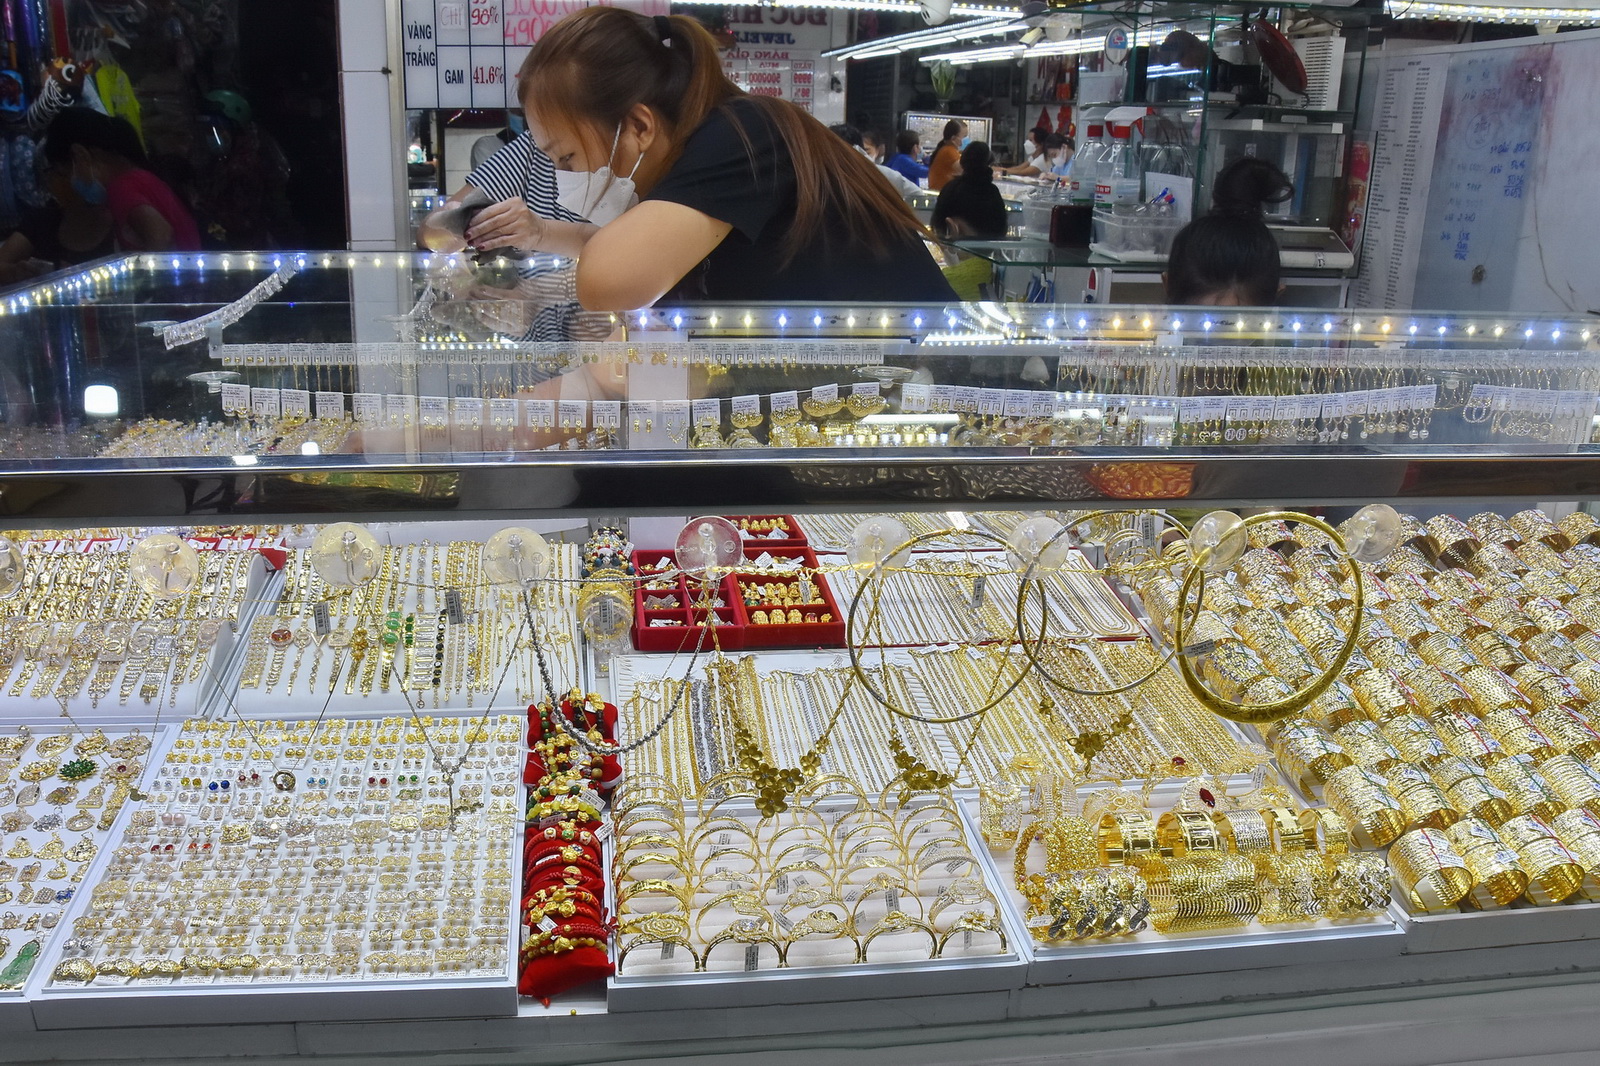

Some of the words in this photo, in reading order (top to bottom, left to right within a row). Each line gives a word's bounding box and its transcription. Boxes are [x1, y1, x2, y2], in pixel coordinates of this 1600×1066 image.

[471, 6, 499, 25] 98%
[407, 21, 432, 40] VÀNG
[405, 45, 436, 67] TRẮNG
[444, 69, 464, 84] GAM
[473, 66, 504, 84] 41.6%
